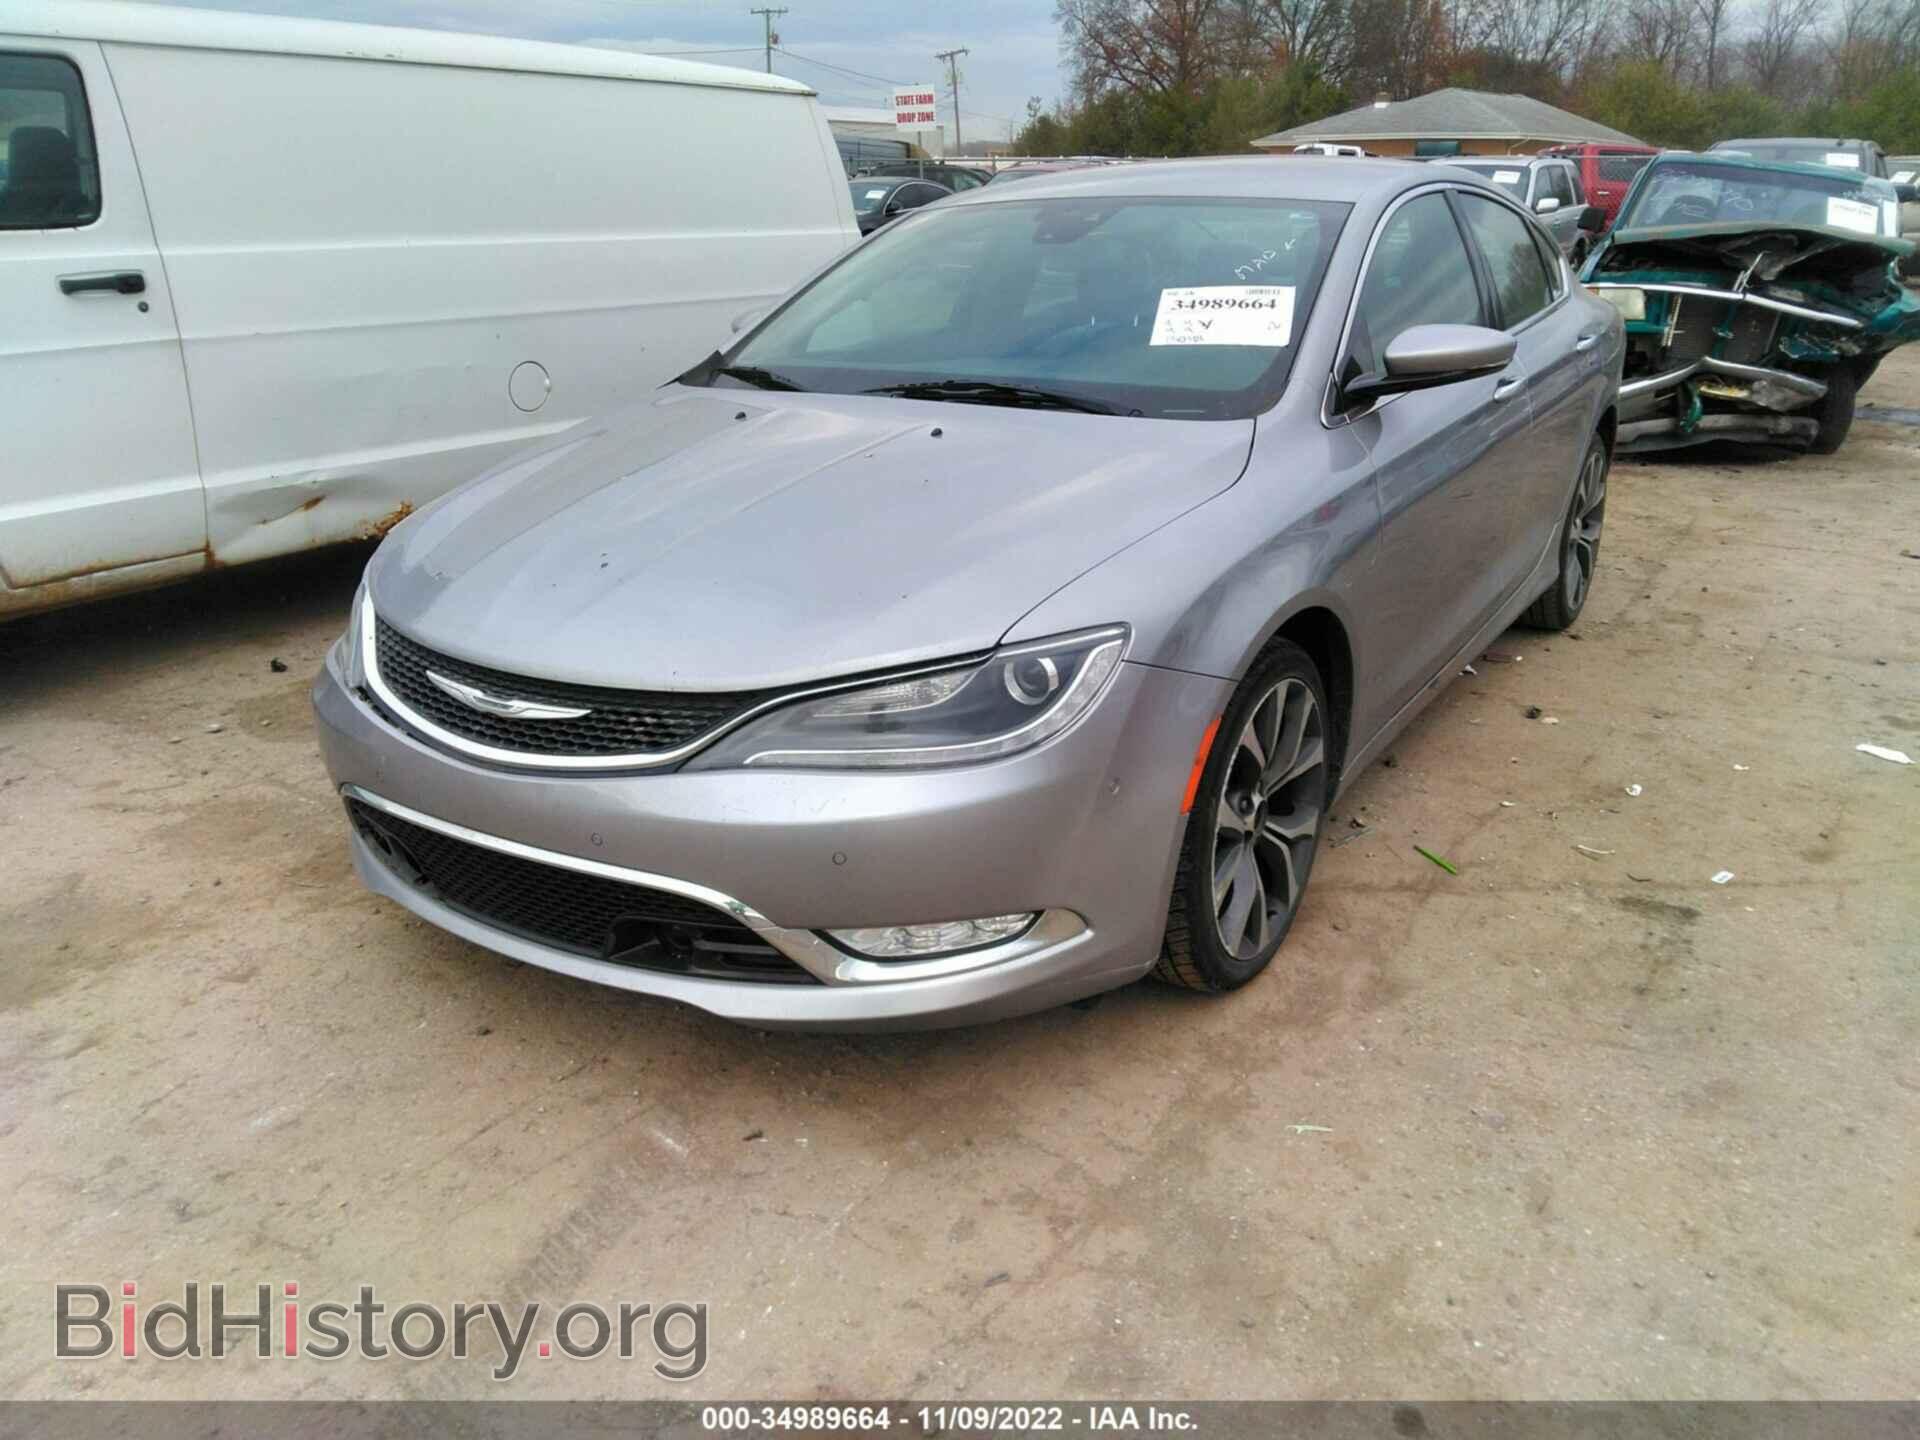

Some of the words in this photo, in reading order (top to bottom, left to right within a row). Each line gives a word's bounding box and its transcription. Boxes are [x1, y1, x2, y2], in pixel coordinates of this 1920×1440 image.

[896, 95, 914, 106] STATE
[916, 94, 934, 104] FARM
[897, 112, 916, 123] DROP
[917, 111, 935, 122] ZONE
[1174, 298, 1276, 310] 34989664
